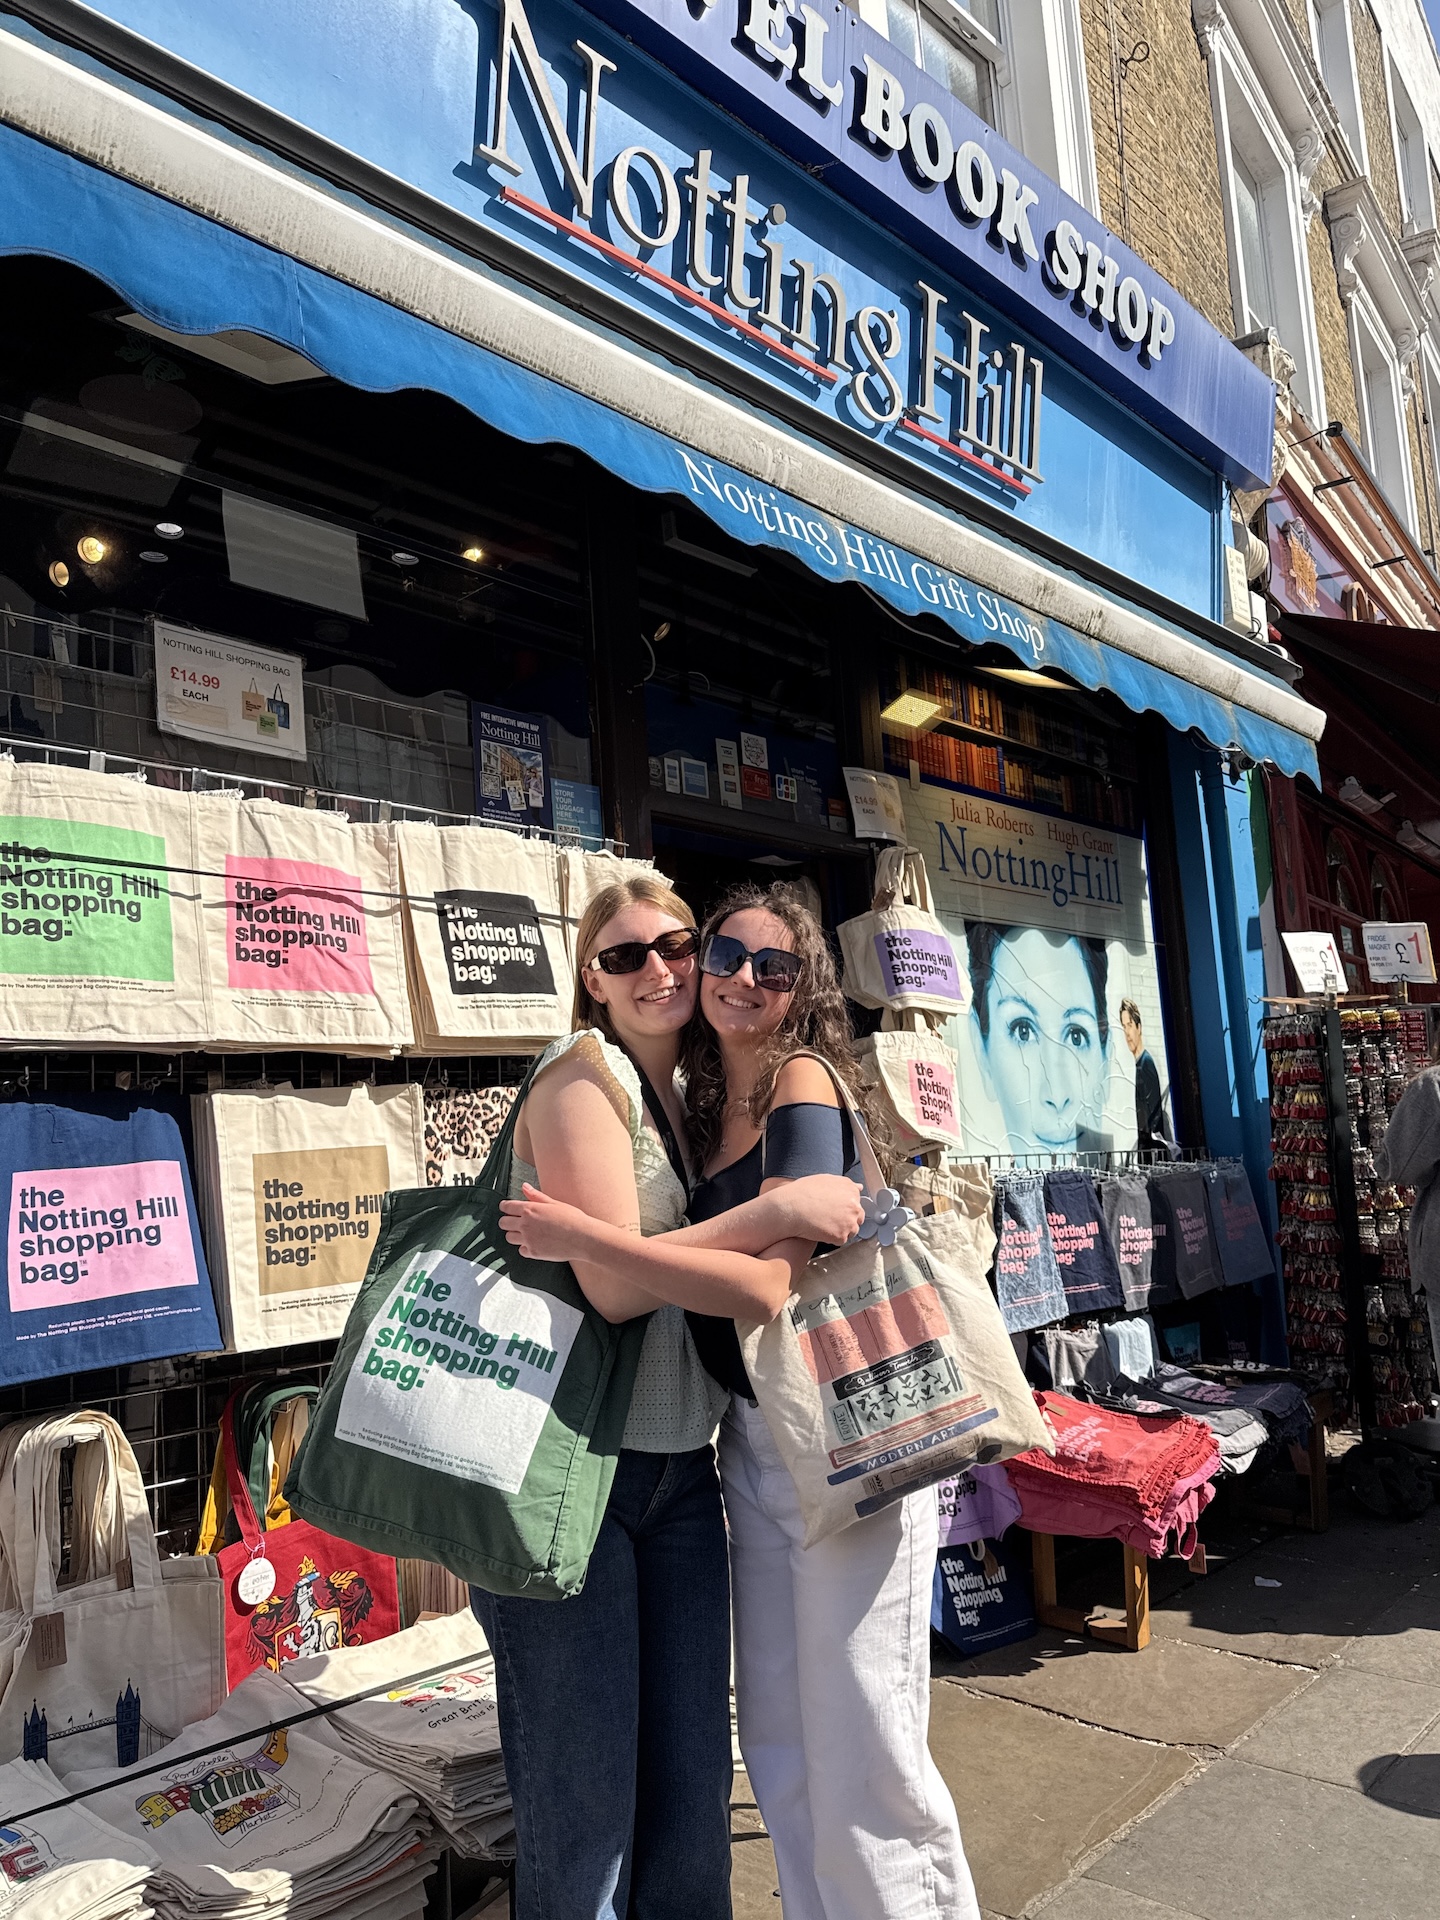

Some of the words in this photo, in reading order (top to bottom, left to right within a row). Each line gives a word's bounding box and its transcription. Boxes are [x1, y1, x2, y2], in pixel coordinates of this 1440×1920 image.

[704, 0, 843, 107] EL
[858, 53, 1041, 261] BOOK
[1052, 220, 1174, 360] SHOP
[479, 0, 899, 422] Notting
[914, 281, 1045, 483] Hill
[676, 449, 838, 566] Notting
[837, 526, 909, 588] Hill
[911, 563, 974, 619] Gift
[976, 591, 1044, 660] Shop
[163, 638, 202, 654] NOTTING
[205, 650, 224, 660] HILL
[226, 653, 270, 671] SHOPPING
[273, 665, 290, 676] BAG
[170, 666, 220, 689] £14.99
[182, 689, 209, 701] EACH
[481, 712, 491, 720] FREE
[491, 714, 517, 727] INTERACTIVE
[481, 722, 520, 745] Notting
[522, 732, 541, 746] Hill
[555, 789, 574, 798] STORE
[555, 797, 572, 805] YOUR
[556, 804, 584, 814] LUGGAGE
[556, 811, 573, 819] HERE
[950, 797, 981, 824] Julia
[986, 807, 1034, 837] Roberts
[1047, 821, 1079, 852] Hugh
[1083, 832, 1114, 855] Grant
[0, 842, 51, 863] the
[935, 821, 1067, 907] Notting
[1067, 851, 1123, 905] Hill
[0, 864, 113, 898] Notting
[122, 873, 160, 900] Hill
[235, 881, 278, 902] the
[0, 889, 142, 923] shopping
[235, 902, 325, 932] Notting
[330, 913, 361, 936] Hill
[235, 924, 348, 953] shopping
[448, 921, 518, 946] Notting
[519, 923, 541, 946] Hill
[885, 935, 912, 948] the
[451, 941, 535, 966] shopping
[887, 948, 937, 966] Notting
[939, 953, 952, 968] Hill
[1368, 943, 1391, 951] MAGNET
[891, 961, 948, 981] shopping
[915, 1063, 934, 1078] the
[20, 1186, 65, 1208] the
[263, 1179, 303, 1199] the
[19, 1207, 128, 1234] Notting
[136, 1196, 179, 1220] Hill
[264, 1199, 350, 1223] Notting
[355, 1194, 383, 1215] Hill
[1047, 1212, 1066, 1225] the
[1176, 1207, 1193, 1220] the
[264, 1220, 369, 1244] shopping
[1050, 1225, 1087, 1239] Notting
[1086, 1221, 1099, 1235] Hill
[1119, 1215, 1136, 1227] the
[1120, 1227, 1153, 1240] Notting
[1153, 1224, 1167, 1236] Hill
[19, 1224, 161, 1257] shopping
[1052, 1238, 1094, 1252] shopping
[404, 1270, 451, 1302] the
[48, 1328, 68, 1336] Notting
[79, 1322, 105, 1332] Shopping
[117, 1315, 143, 1324] Company
[387, 1296, 499, 1356] Notting
[505, 1333, 558, 1374] Hill
[374, 1326, 520, 1390] shopping
[834, 1411, 851, 1438] ROME
[357, 1432, 366, 1440] The
[366, 1435, 382, 1447] Notting
[382, 1440, 390, 1448] Hill
[390, 1443, 411, 1456] Shopping
[411, 1449, 420, 1459] Bag
[421, 1453, 444, 1466] Company
[866, 1439, 924, 1471] MODERN
[931, 1426, 956, 1446] ART
[941, 1558, 965, 1575] the
[947, 1572, 985, 1593] Notting
[953, 1587, 1004, 1610] shopping
[419, 1702, 441, 1714] Spring
[466, 1710, 486, 1722] This
[428, 1711, 459, 1729] Great
[239, 1812, 277, 1835] Market
